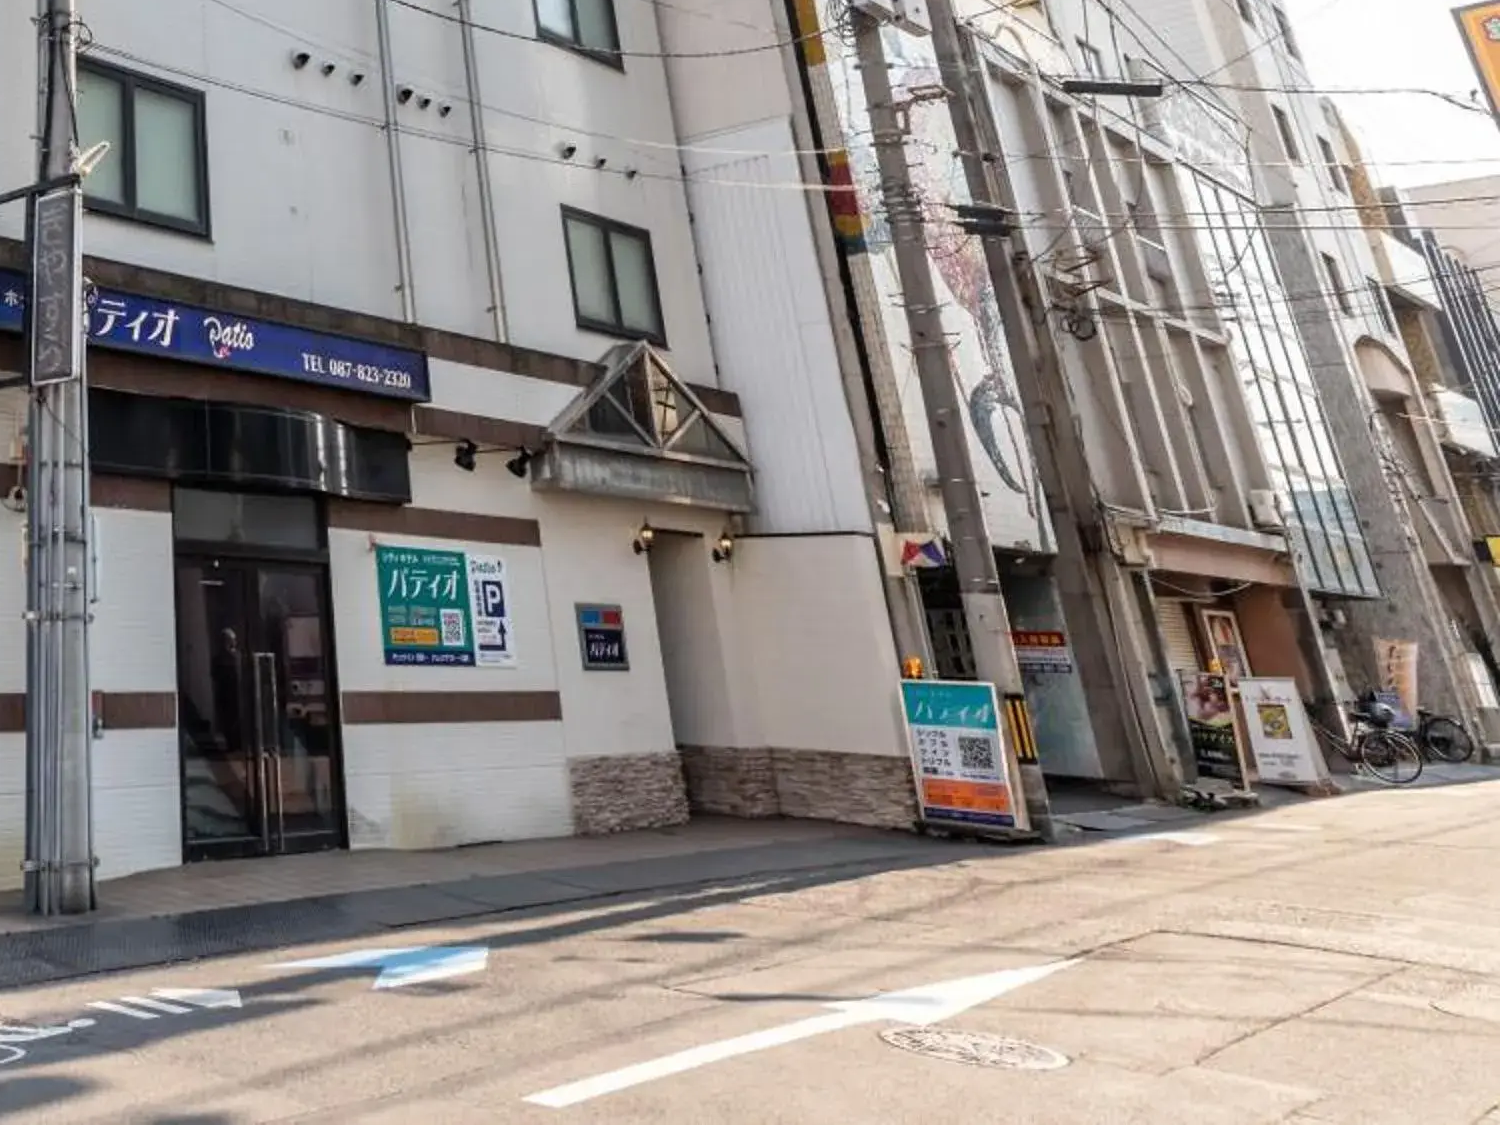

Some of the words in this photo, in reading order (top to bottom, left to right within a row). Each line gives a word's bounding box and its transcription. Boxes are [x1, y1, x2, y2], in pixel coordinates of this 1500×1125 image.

[203, 316, 255, 359] Patio
[302, 352, 326, 375] TEL
[387, 567, 460, 601] パティオ
[485, 584, 501, 614] P
